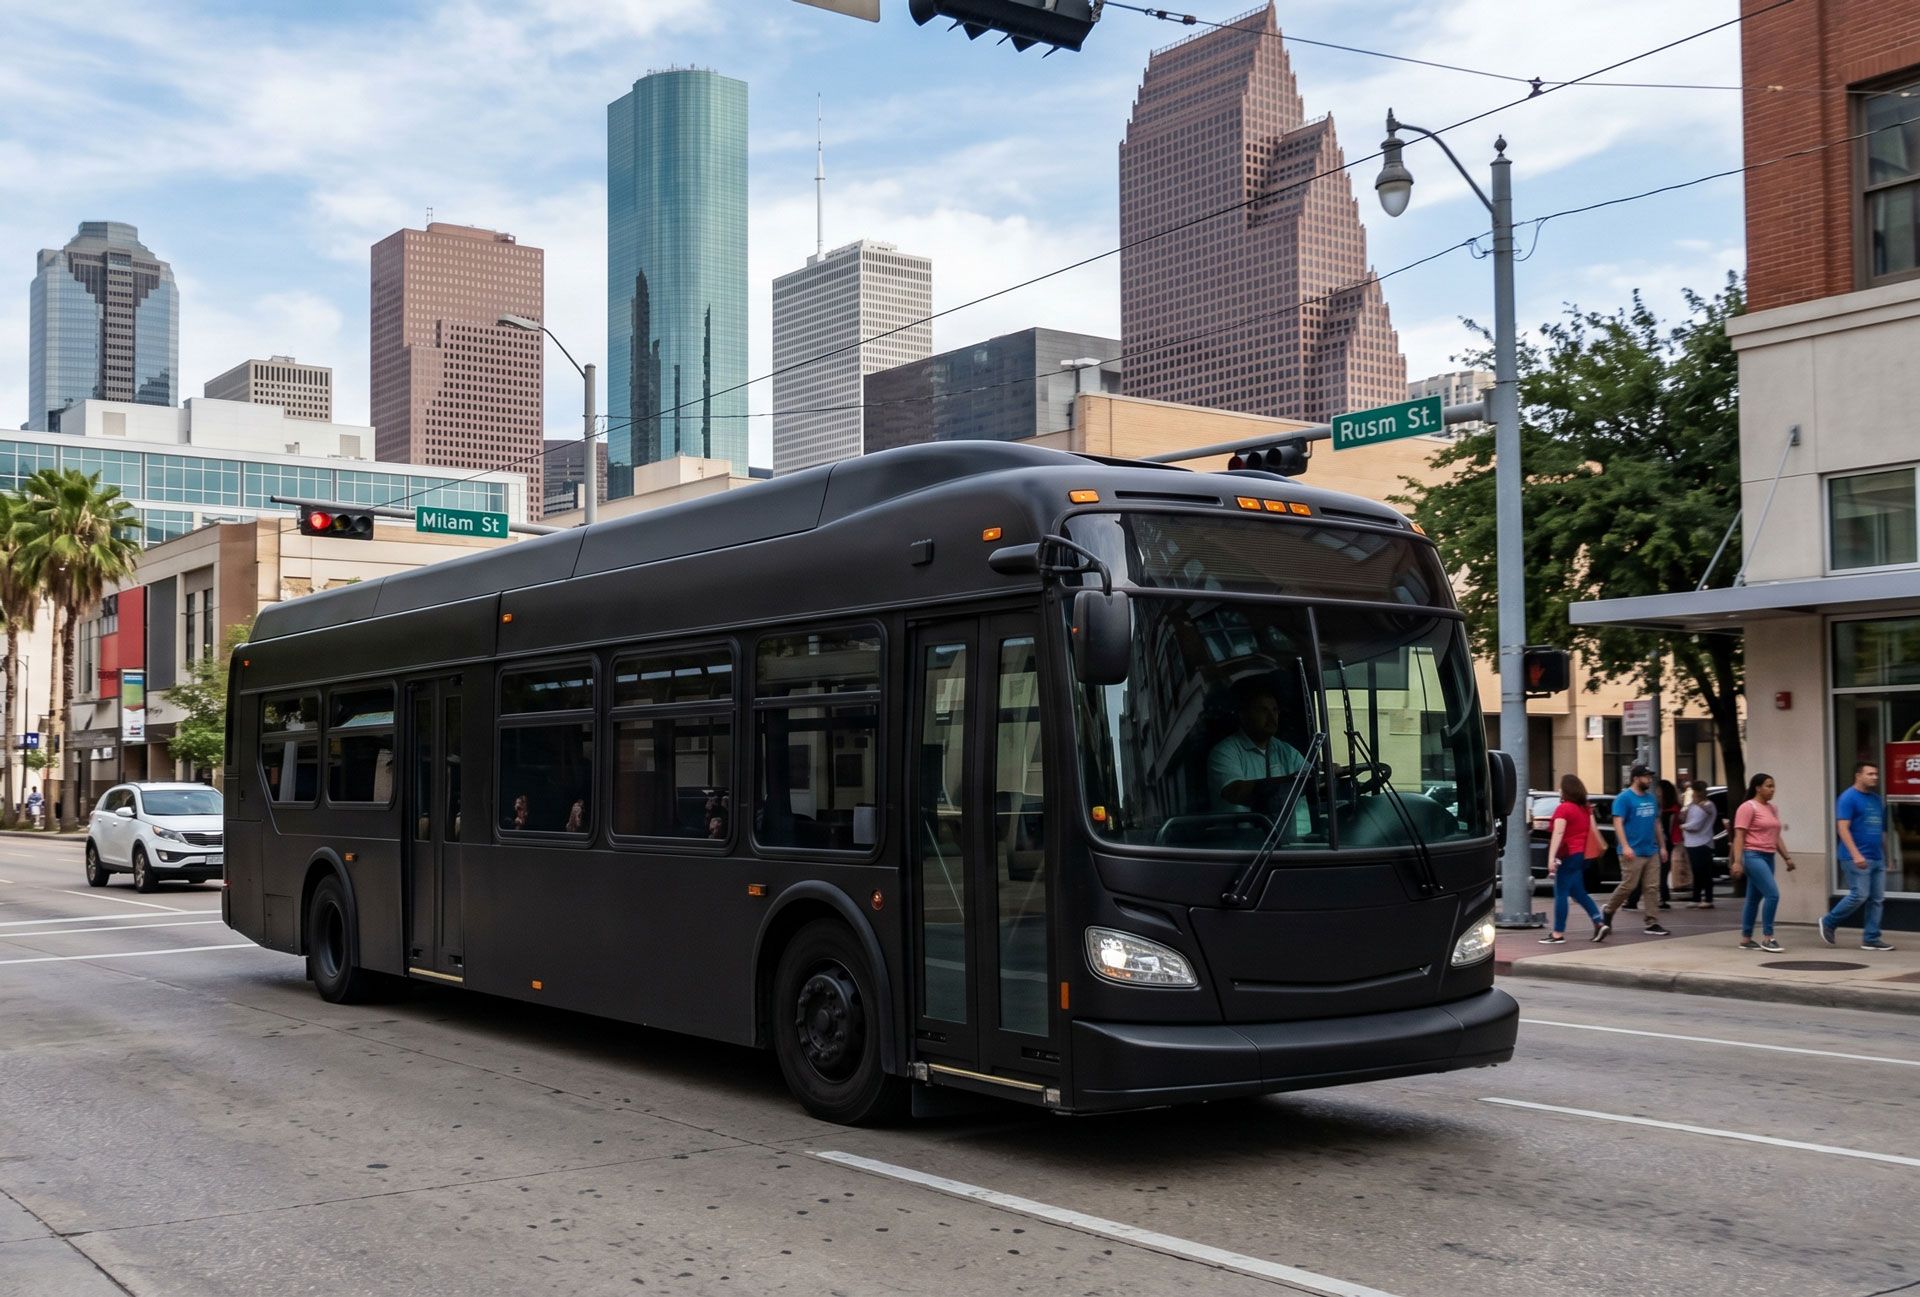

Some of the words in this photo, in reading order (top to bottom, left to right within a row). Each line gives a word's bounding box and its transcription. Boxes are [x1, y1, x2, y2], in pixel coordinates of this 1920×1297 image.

[1340, 416, 1397, 442] Rusm
[1407, 406, 1436, 429] St.
[422, 511, 473, 531] Milam
[482, 516, 500, 533] St
